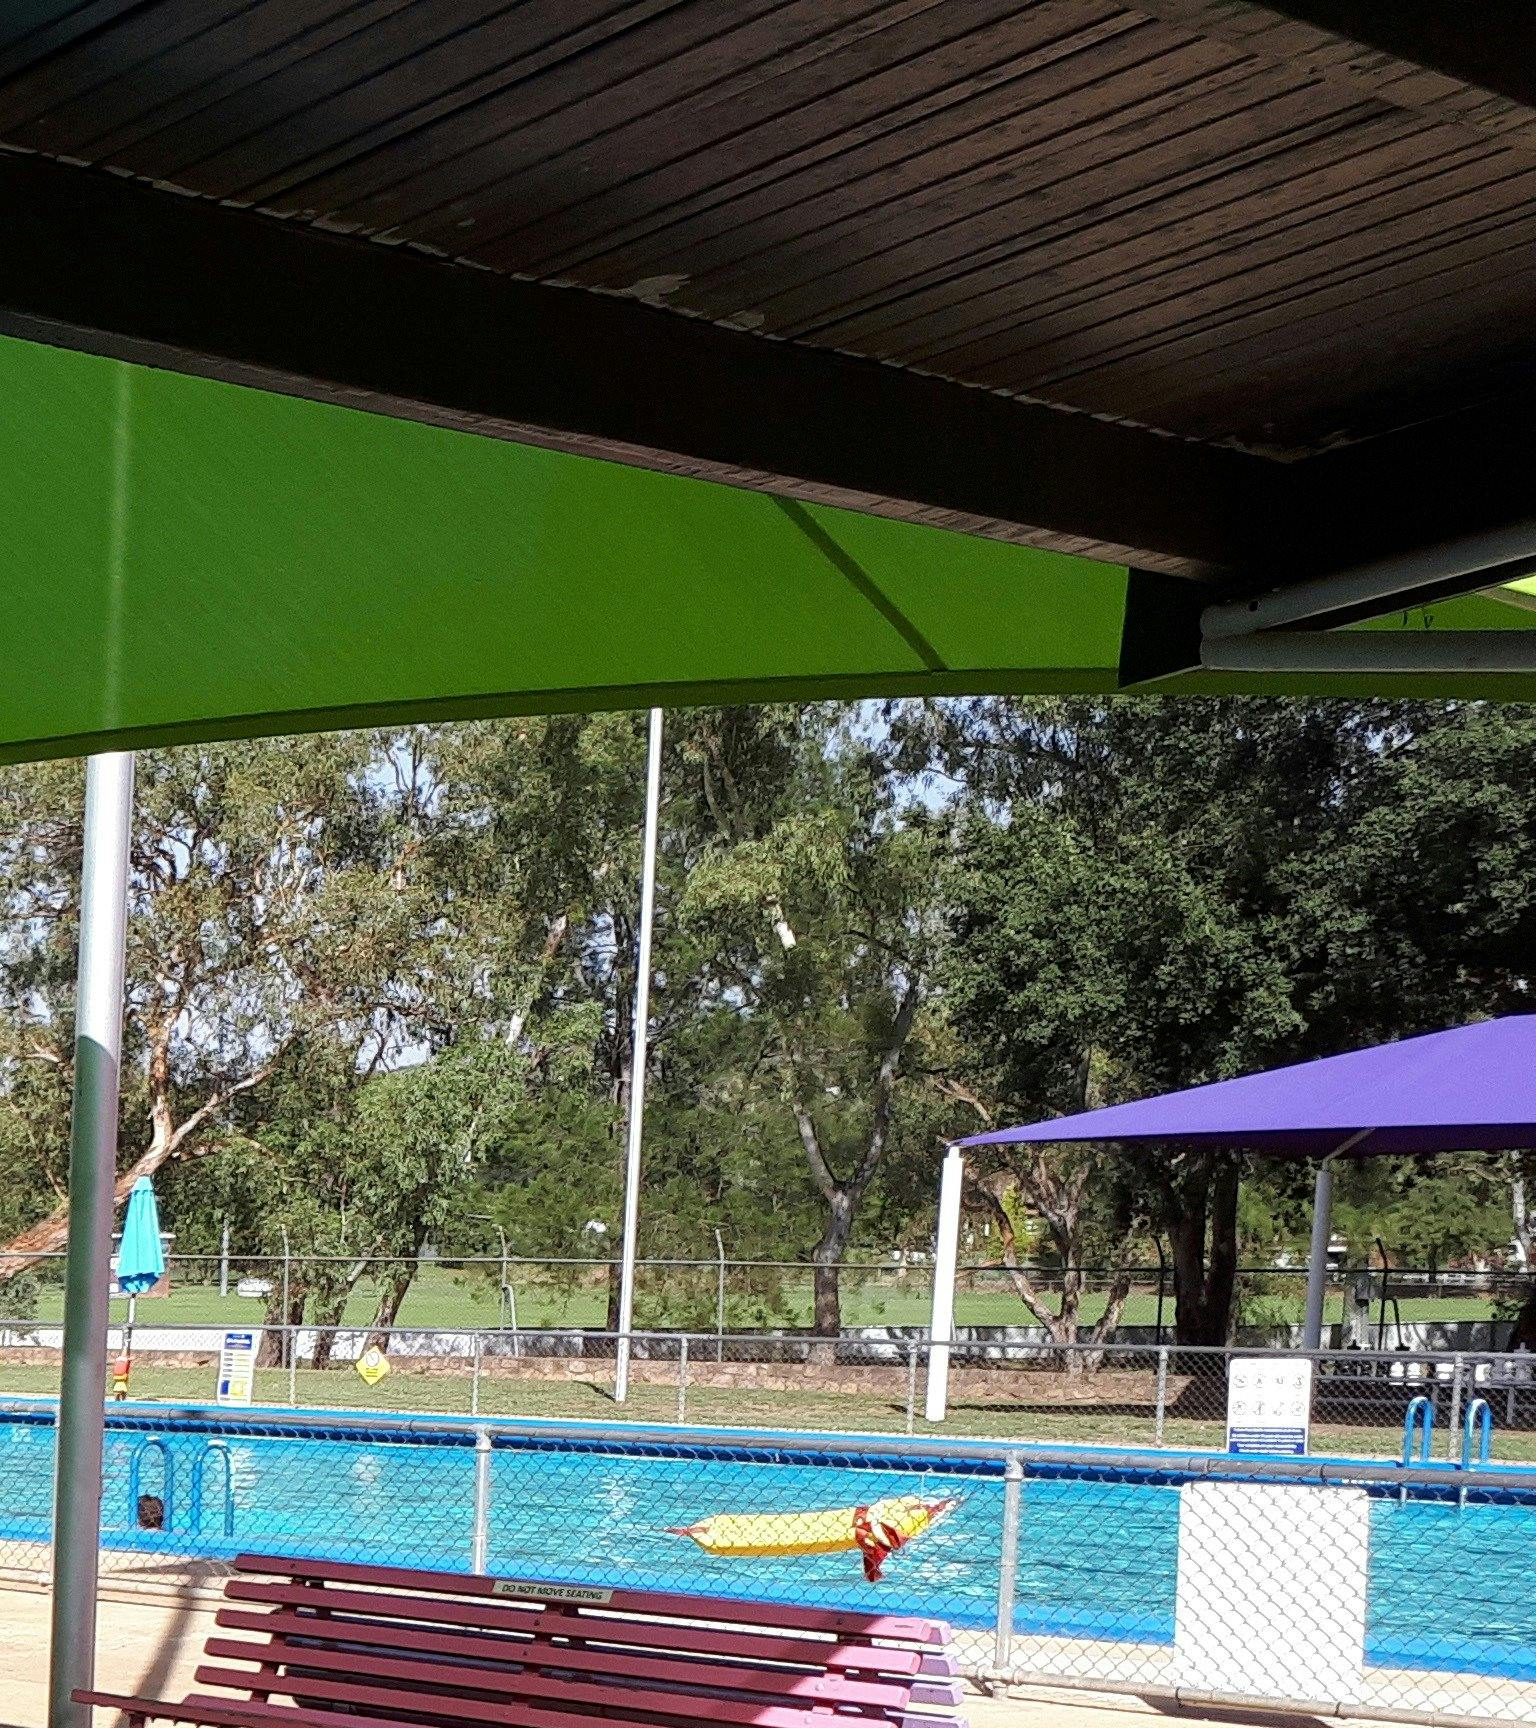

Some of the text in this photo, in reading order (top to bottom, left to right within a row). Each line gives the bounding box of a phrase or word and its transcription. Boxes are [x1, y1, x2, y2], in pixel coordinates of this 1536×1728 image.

[502, 1584, 603, 1600] DO NOT MOVE SEATING
